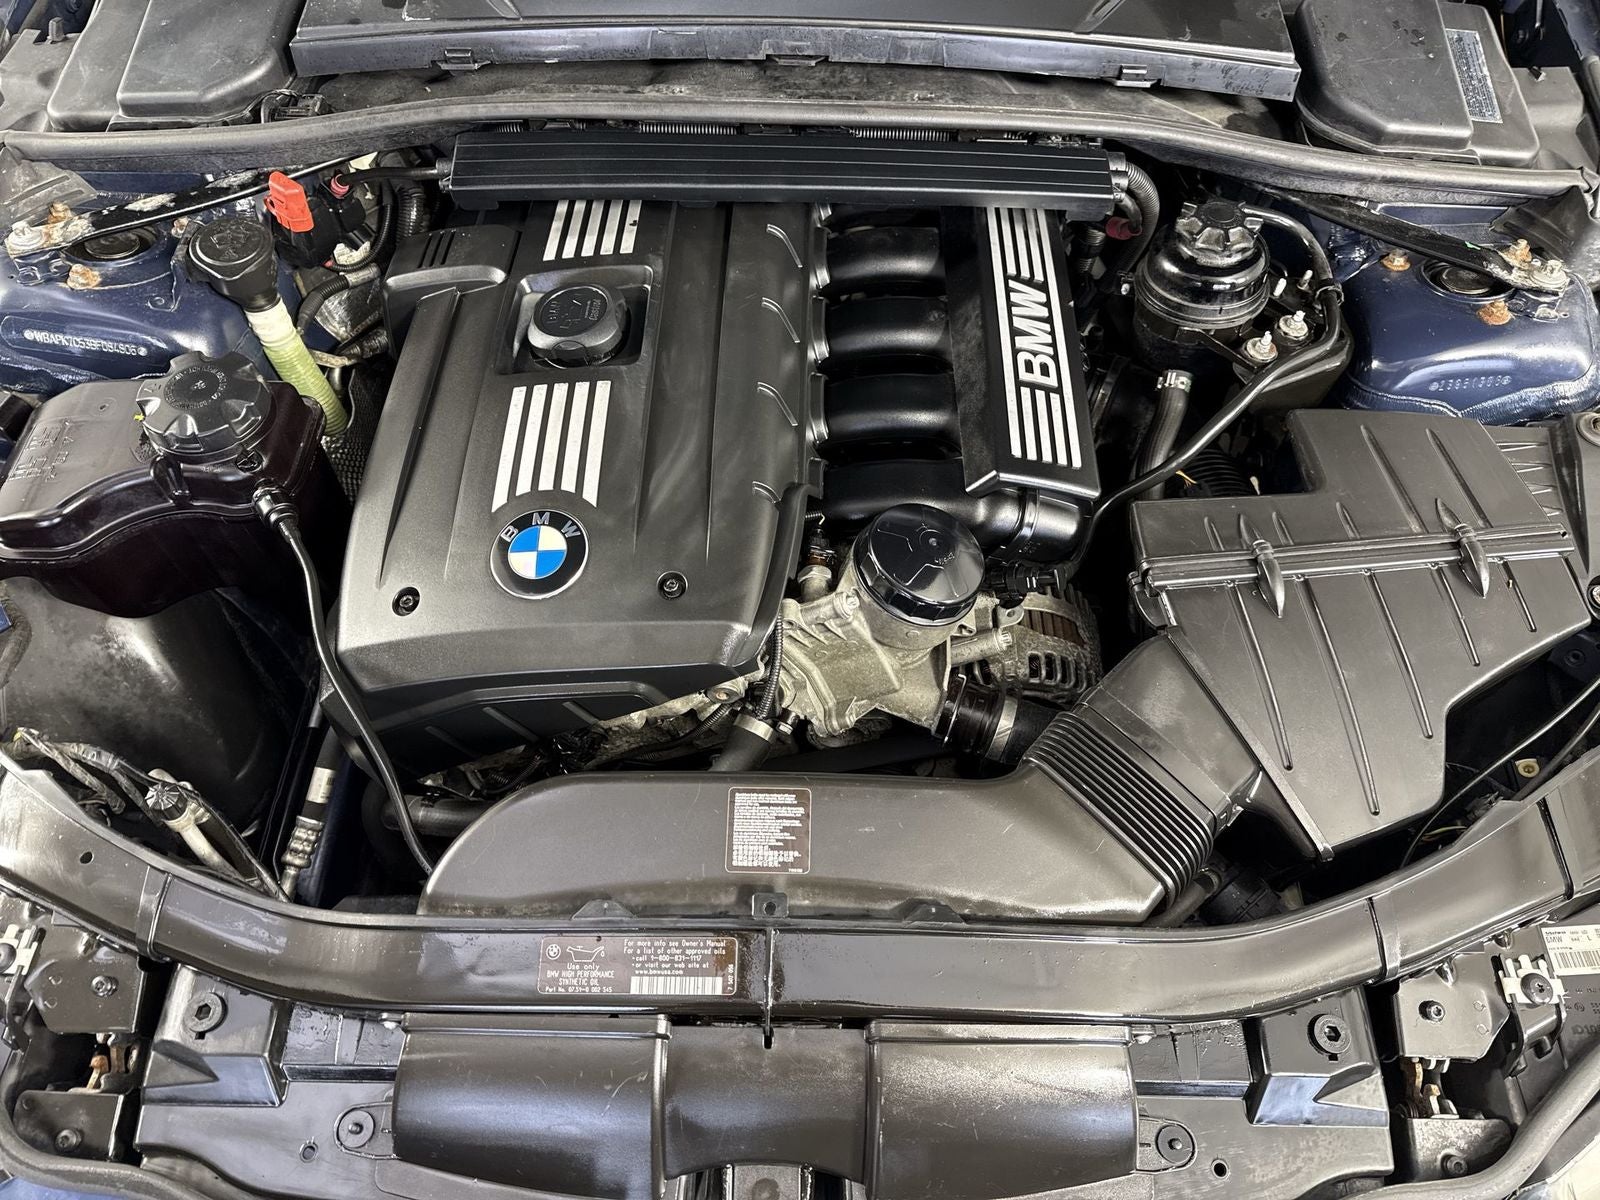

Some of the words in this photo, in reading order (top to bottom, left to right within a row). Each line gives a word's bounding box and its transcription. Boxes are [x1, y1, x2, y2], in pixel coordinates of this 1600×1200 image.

[1008, 279, 1059, 389] BMW
[500, 512, 581, 543] BMW
[624, 939, 634, 947] For
[654, 939, 667, 947] info
[681, 939, 704, 947] Owner's
[706, 939, 726, 947] Manual
[623, 947, 634, 955] For
[643, 947, 654, 955] list
[657, 947, 665, 955] of
[666, 947, 682, 955] other
[685, 947, 712, 956] approved
[714, 947, 726, 955] oils
[567, 962, 580, 970] Use
[583, 962, 600, 972] only
[546, 969, 560, 978] BMW
[561, 969, 575, 978] HIGH
[576, 969, 615, 978] PERFORMANCE
[558, 977, 588, 986] SYNTHETIC
[589, 977, 600, 986] OIL
